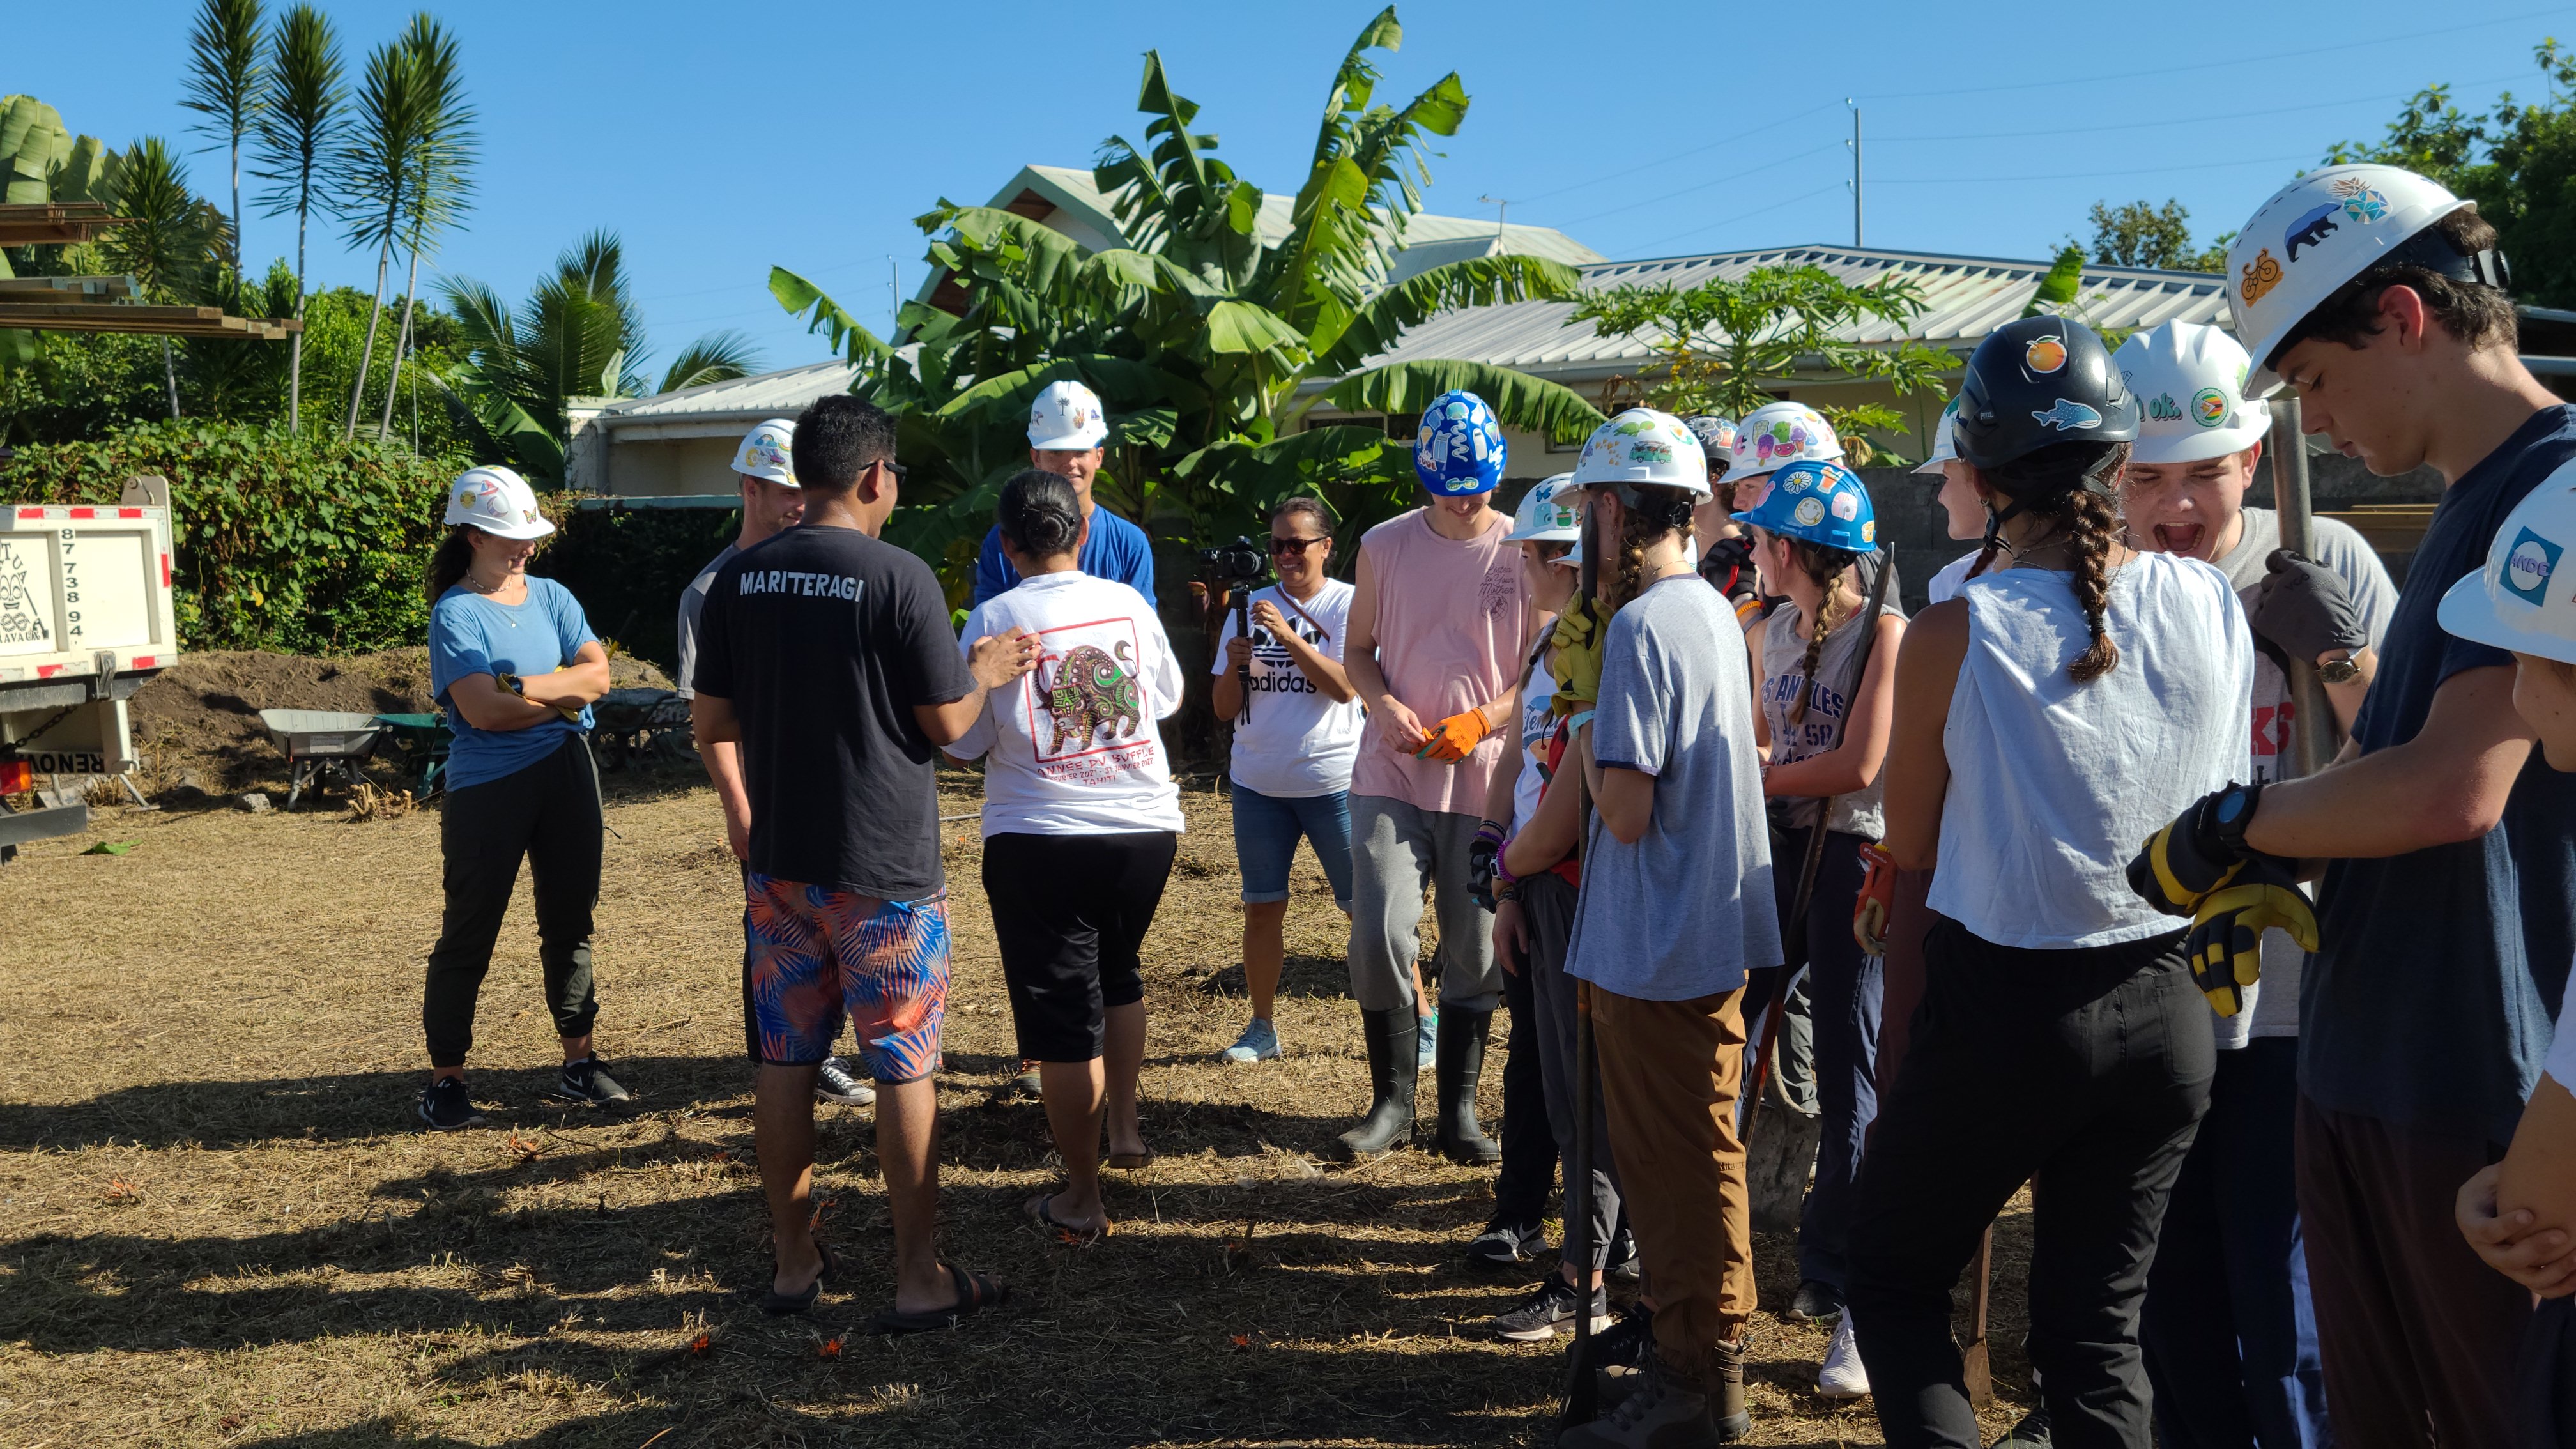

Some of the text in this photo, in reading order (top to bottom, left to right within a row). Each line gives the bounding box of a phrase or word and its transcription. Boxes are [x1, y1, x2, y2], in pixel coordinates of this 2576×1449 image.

[1485, 563, 1513, 576] Listen
[740, 571, 864, 602] MARITERAGI
[1493, 574, 1515, 586] Your
[1478, 583, 1515, 597] Mother
[1250, 671, 1317, 694] adidas
[1774, 673, 1844, 720] ANLES
[1089, 756, 1106, 767] DU
[1112, 746, 1154, 764] BUFFLE
[1114, 762, 1140, 773] JANVIER
[1083, 775, 1116, 785] TAHITI
